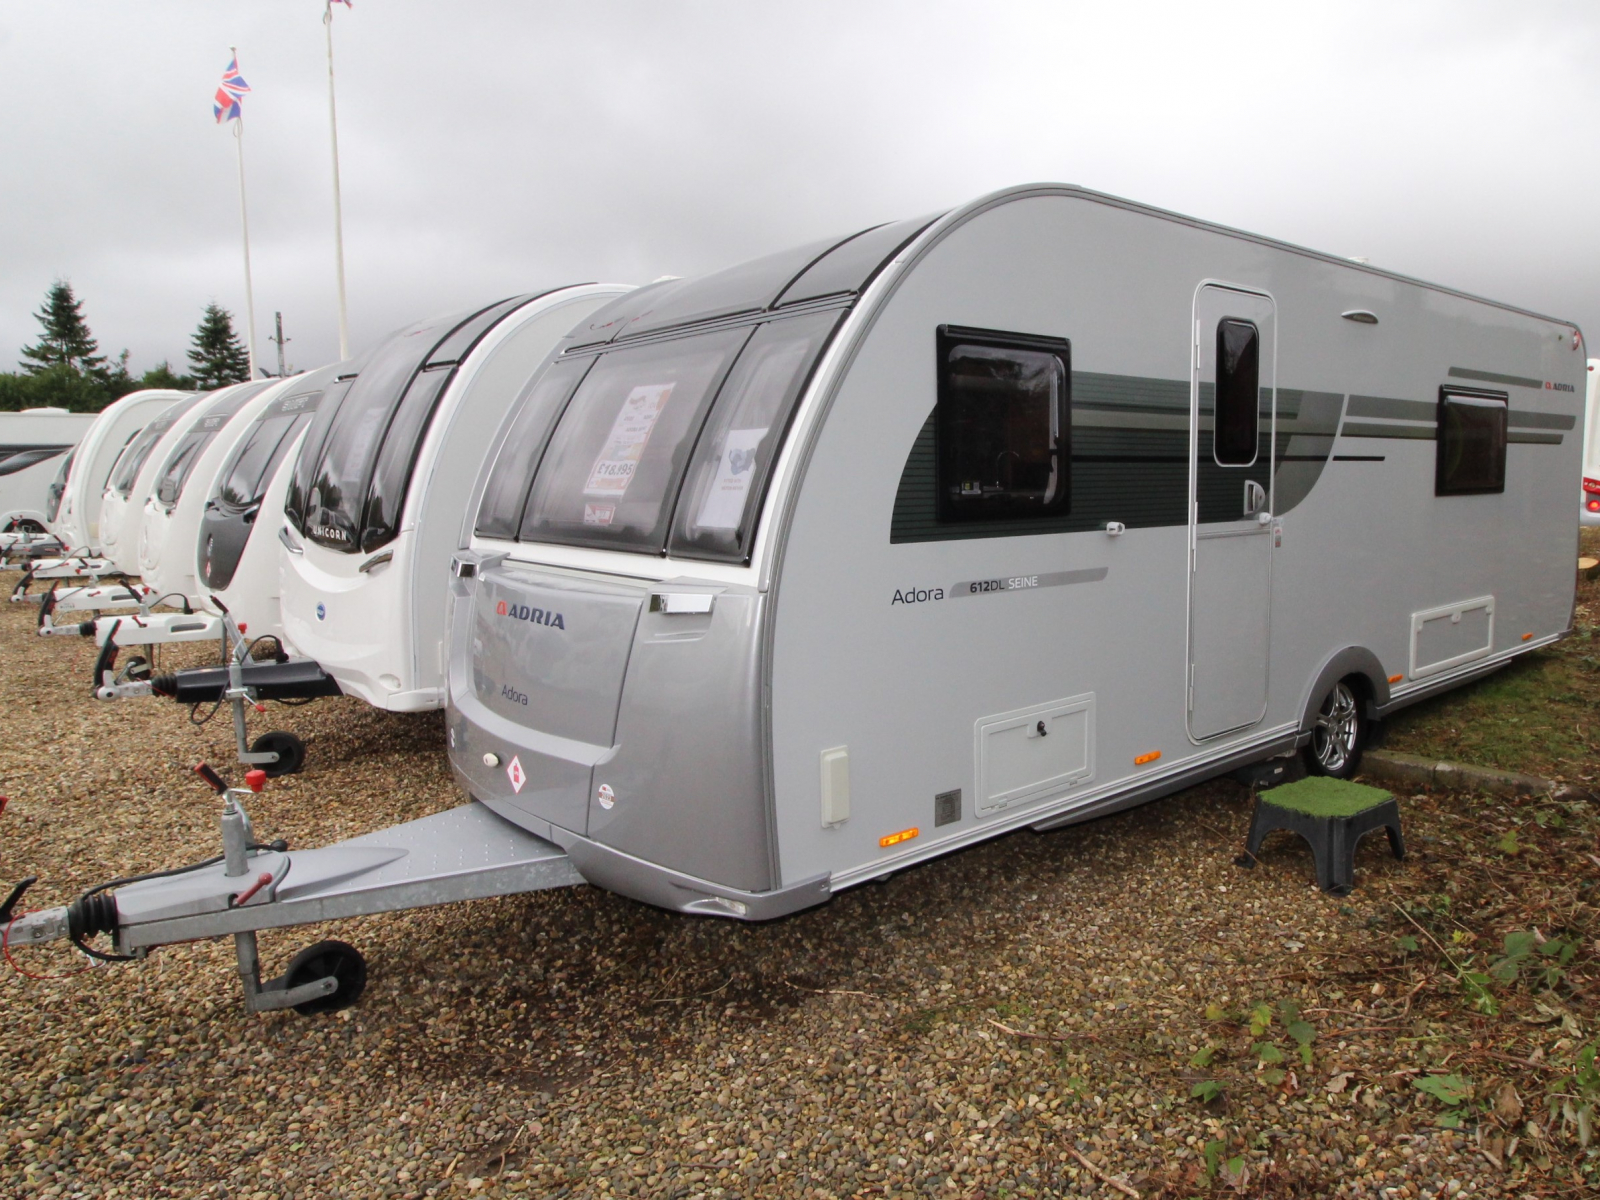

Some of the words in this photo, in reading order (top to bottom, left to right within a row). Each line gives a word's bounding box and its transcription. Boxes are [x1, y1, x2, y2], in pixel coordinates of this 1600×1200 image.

[1553, 382, 1575, 392] ADRIA
[312, 525, 347, 541] UNICORN
[891, 587, 944, 606] Adora
[969, 580, 1005, 593] 612DL
[1008, 576, 1038, 590] SEINE
[508, 603, 565, 630] ADRIA
[501, 684, 528, 706] Adora
